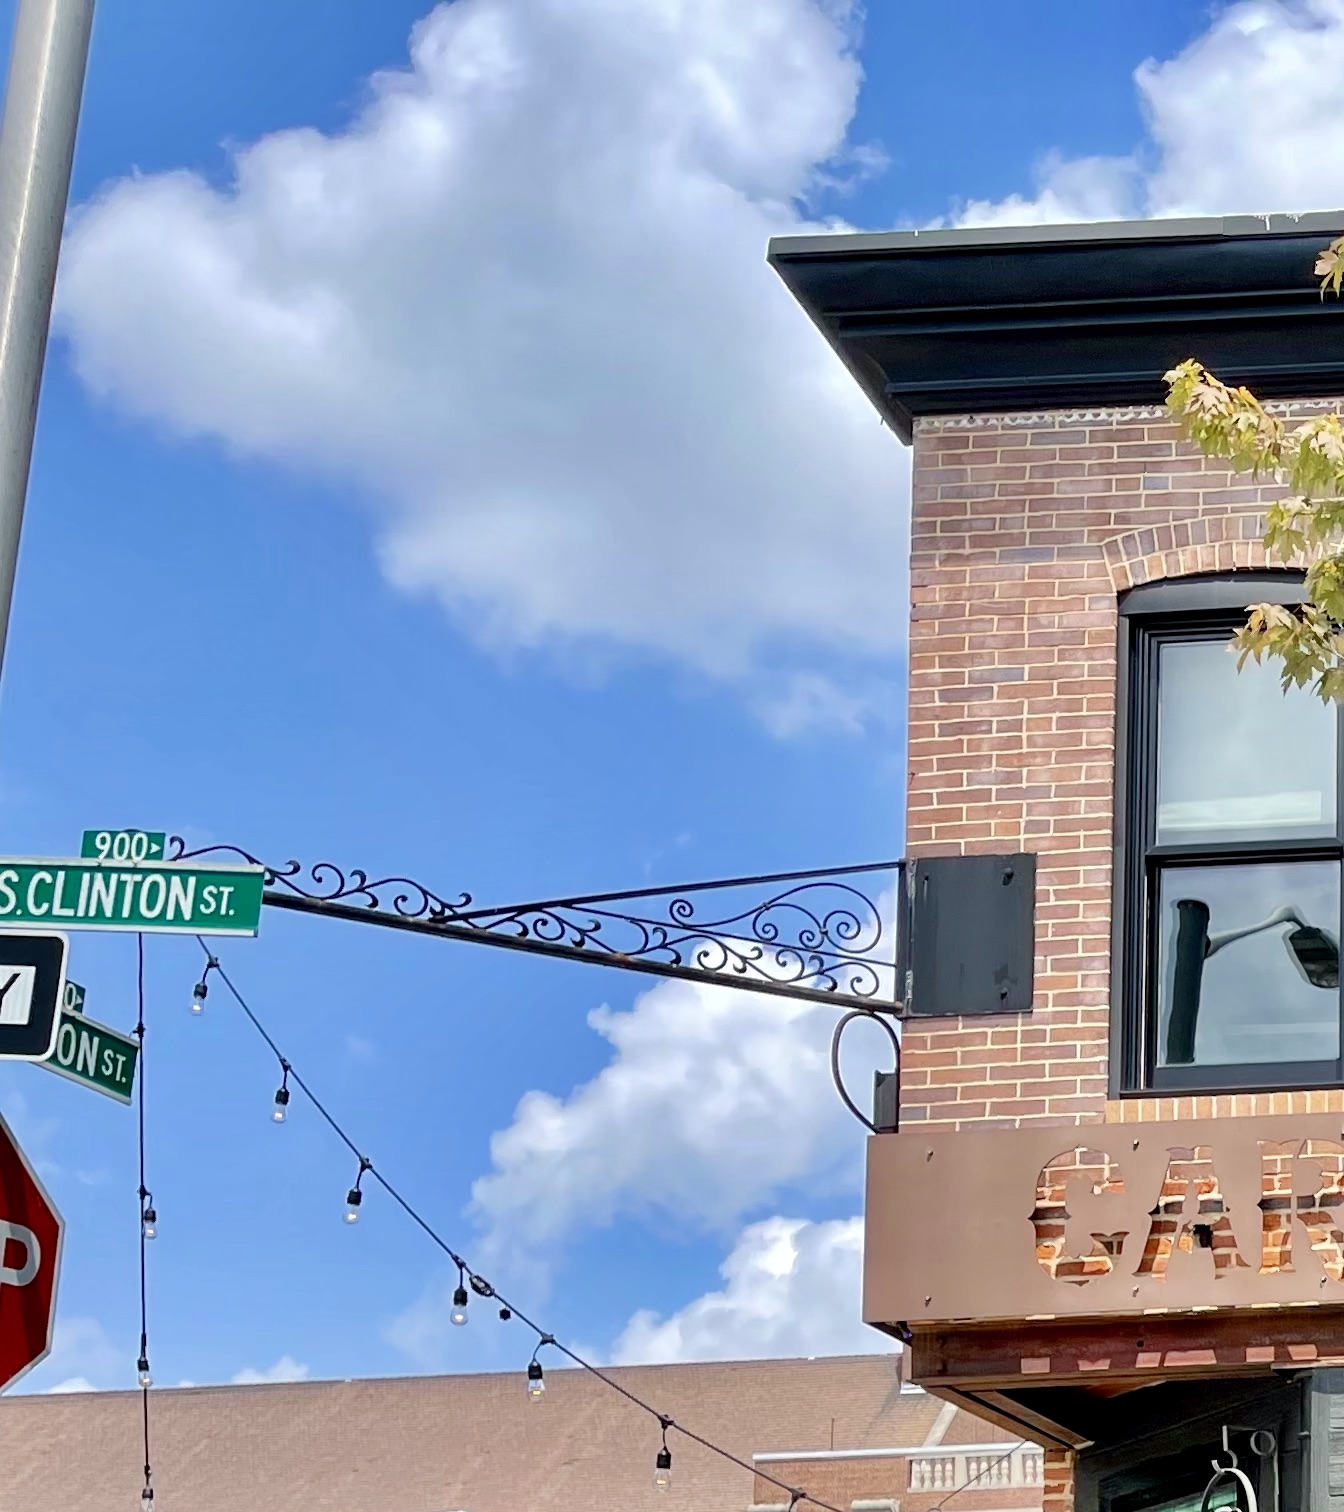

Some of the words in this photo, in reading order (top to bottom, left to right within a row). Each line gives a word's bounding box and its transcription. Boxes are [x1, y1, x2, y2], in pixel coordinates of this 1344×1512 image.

[95, 832, 148, 863] 900
[200, 885, 235, 916] ST.
[102, 1049, 127, 1083] ST.
